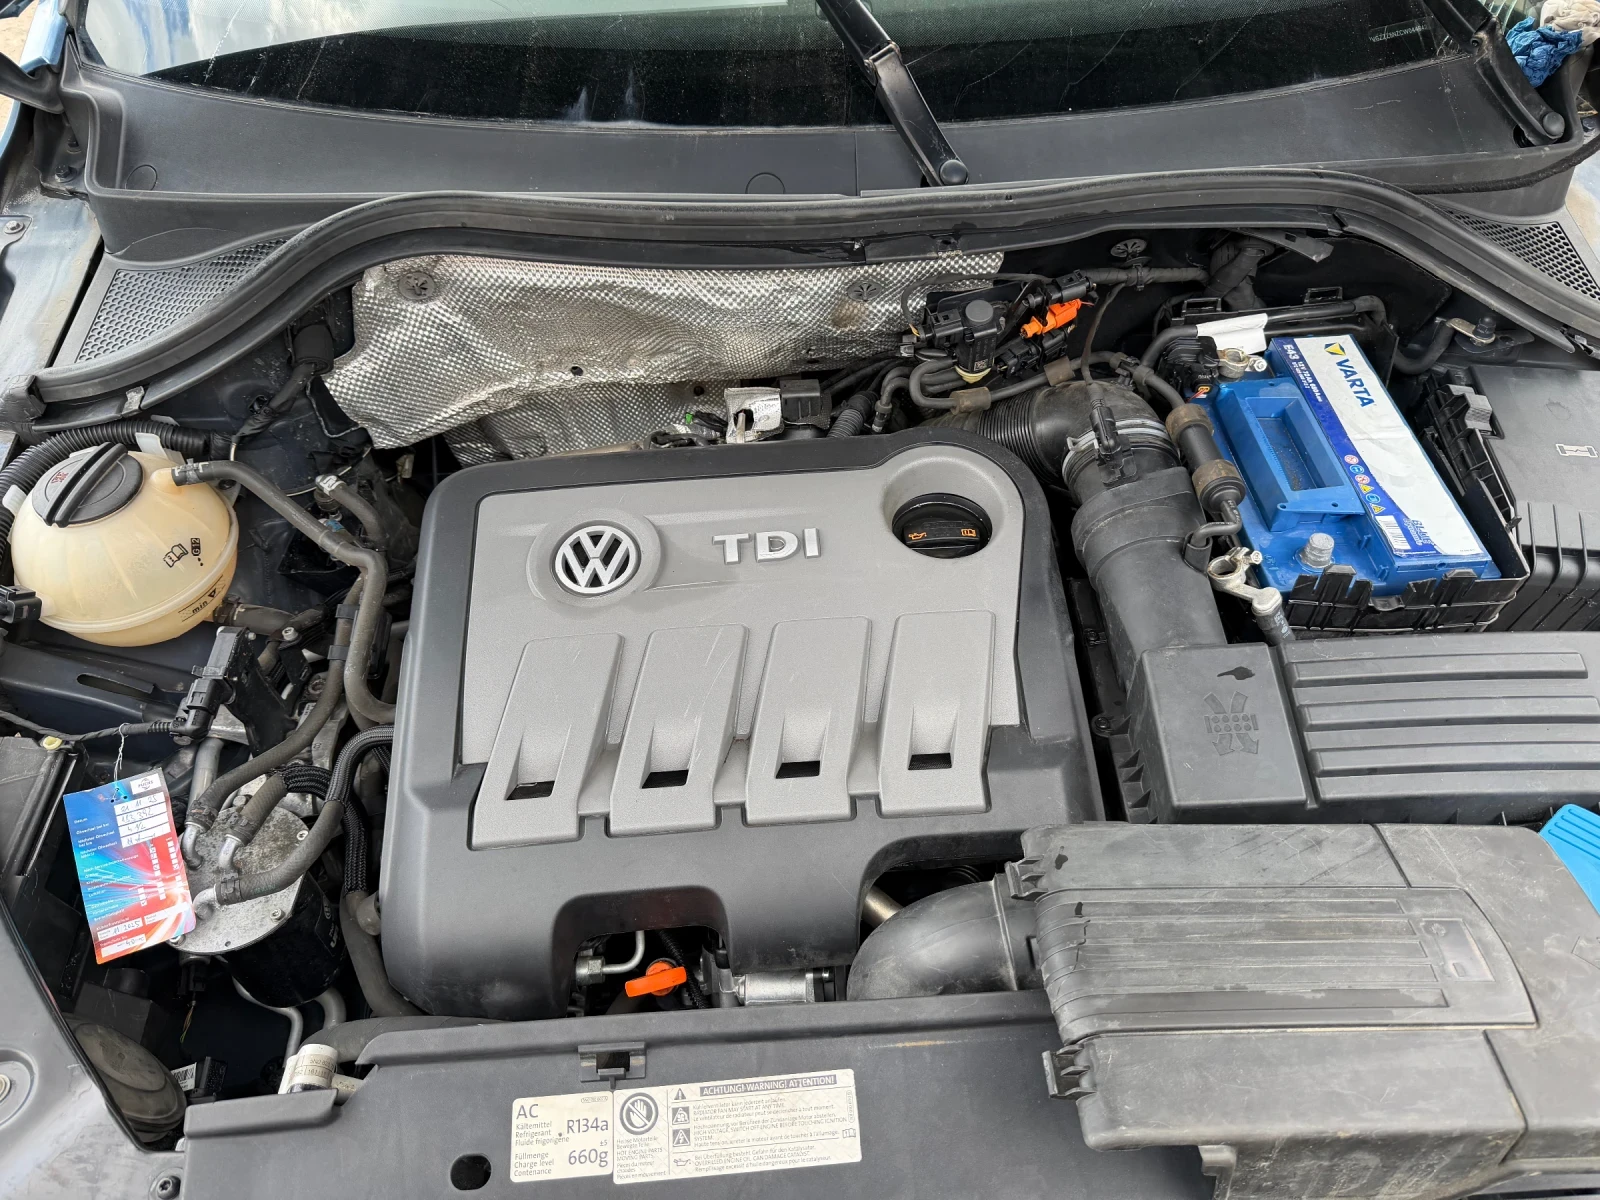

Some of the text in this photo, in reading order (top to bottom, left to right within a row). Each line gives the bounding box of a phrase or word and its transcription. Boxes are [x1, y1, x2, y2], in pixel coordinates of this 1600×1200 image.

[1283, 344, 1299, 360] E43
[1336, 358, 1375, 407] VARTA
[192, 537, 200, 556] G12
[712, 527, 821, 565] TDI
[192, 600, 208, 614] min
[702, 1076, 835, 1095] ACHTUNG! WARNING! ATTENTION!
[516, 1104, 538, 1119] AC
[516, 1120, 552, 1130] Kältemittel
[567, 1117, 608, 1134] R134a
[516, 1129, 551, 1139] Refrigerant
[514, 1158, 554, 1169] Charge level
[515, 1152, 549, 1161] Füllmenge
[568, 1148, 608, 1168] 660g
[514, 1168, 551, 1176] Contenance
